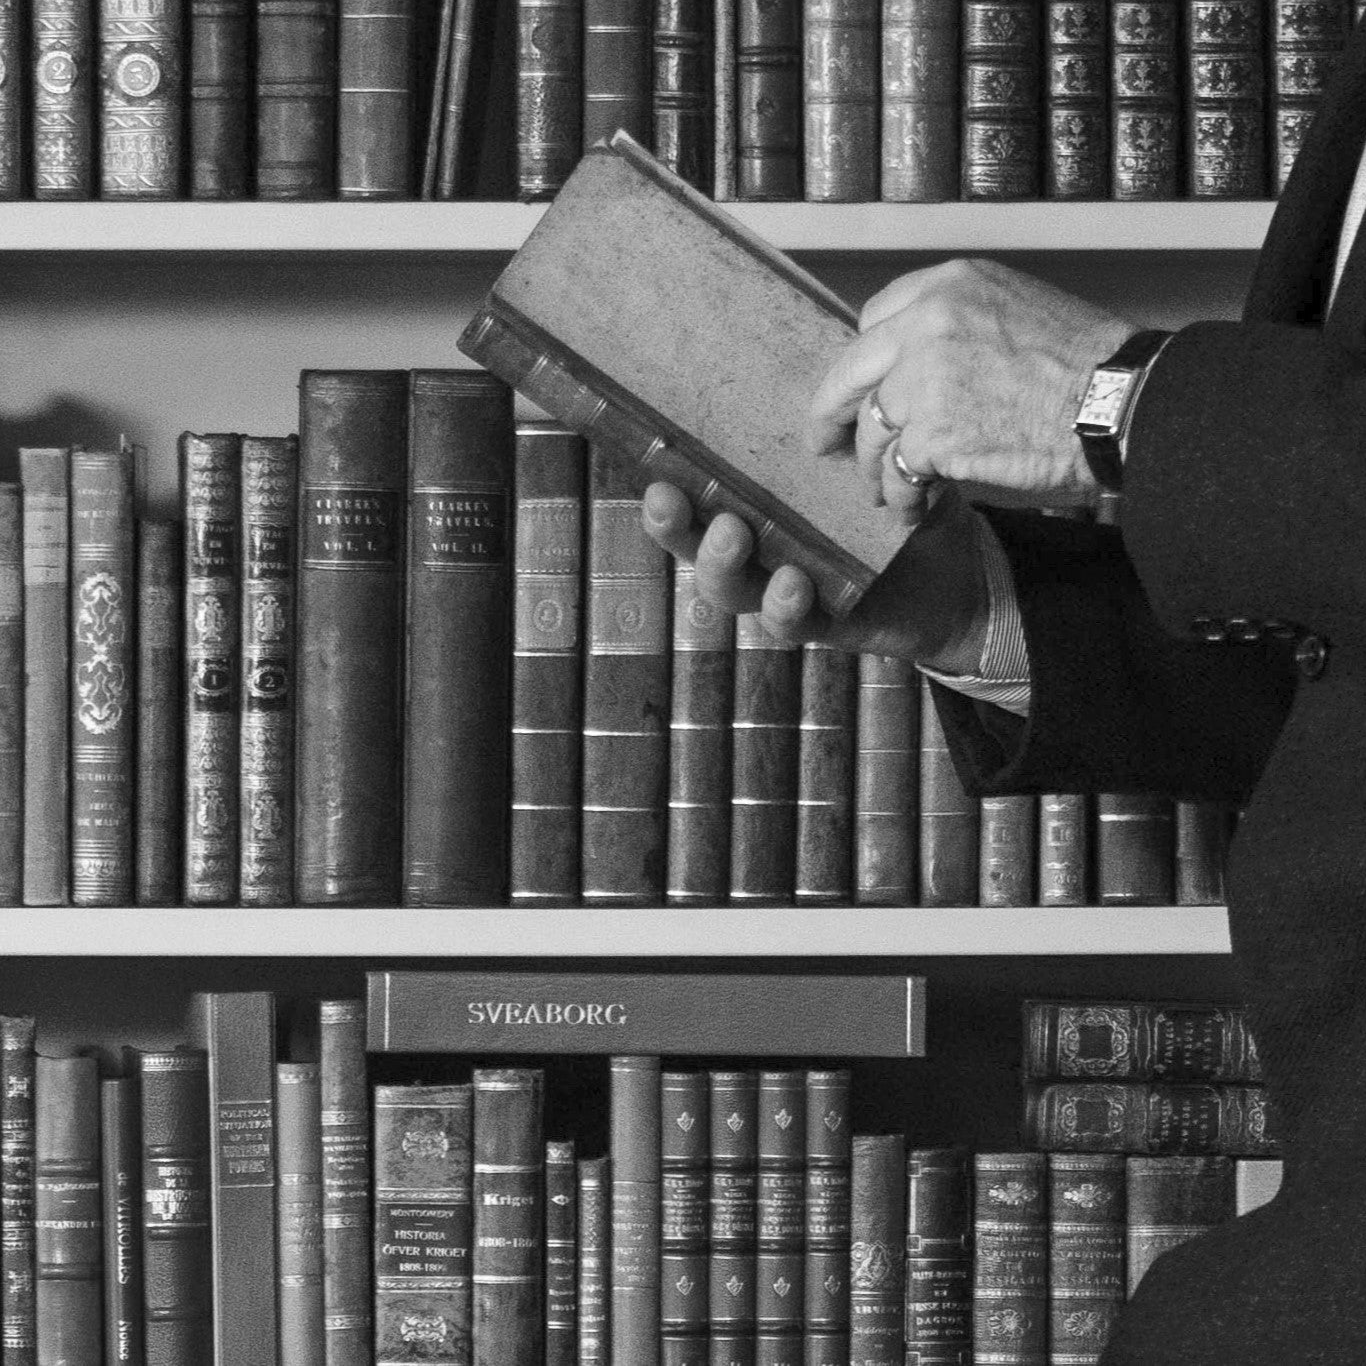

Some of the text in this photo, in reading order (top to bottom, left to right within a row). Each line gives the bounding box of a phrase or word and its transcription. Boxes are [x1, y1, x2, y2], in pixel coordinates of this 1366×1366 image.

[53, 62, 72, 81] 2
[623, 609, 635, 622] 2
[263, 673, 276, 688] 2
[466, 1000, 629, 1026] SVEABORG
[220, 1108, 270, 1119] POLITICAL
[219, 1119, 272, 1130] SITUATION
[483, 1193, 535, 1207] Kriget
[390, 1208, 456, 1220] MONTGOMERY
[117, 1197, 132, 1285] VITROLLES
[393, 1229, 447, 1241] HISTORIA
[382, 1243, 468, 1258] ÖFVER KRIGET
